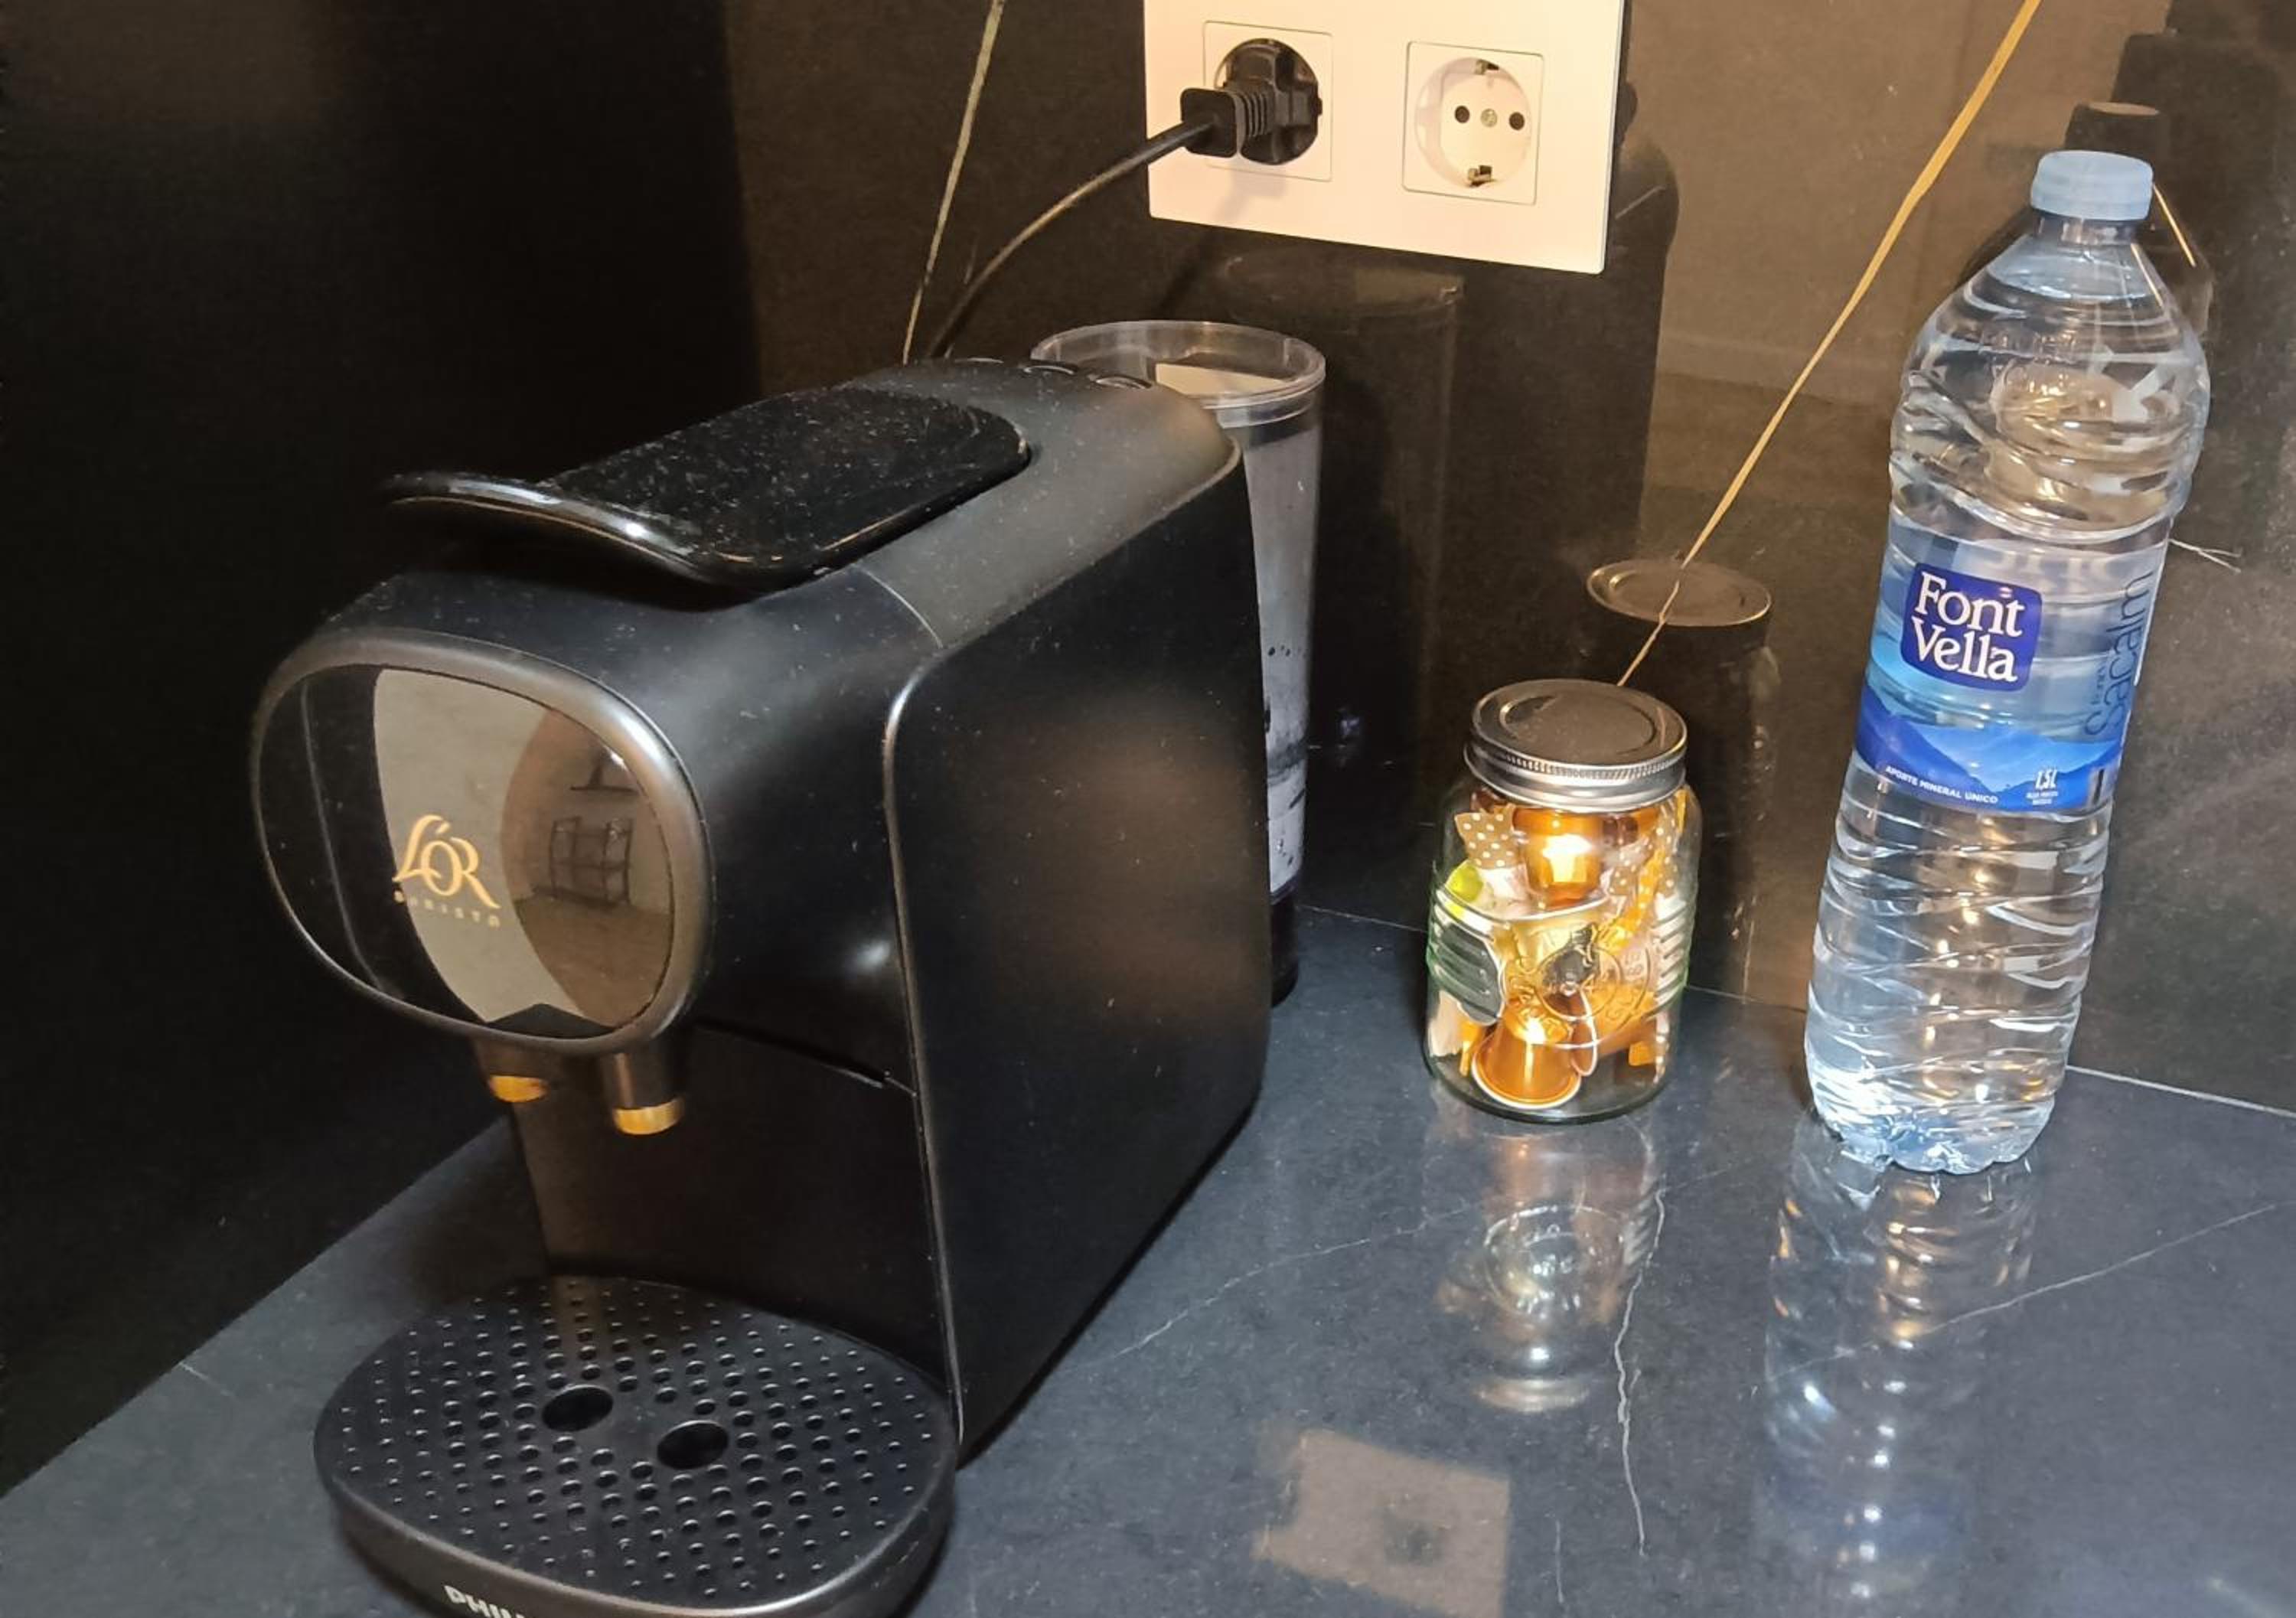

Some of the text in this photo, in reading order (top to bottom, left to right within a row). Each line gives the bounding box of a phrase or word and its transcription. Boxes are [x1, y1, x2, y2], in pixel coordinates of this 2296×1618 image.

[1914, 571, 2025, 638] Font
[1911, 615, 2018, 683] Vella
[1886, 765, 1918, 786] APORTE
[1919, 778, 1962, 800] MINERAL
[392, 814, 501, 908] L'OR
